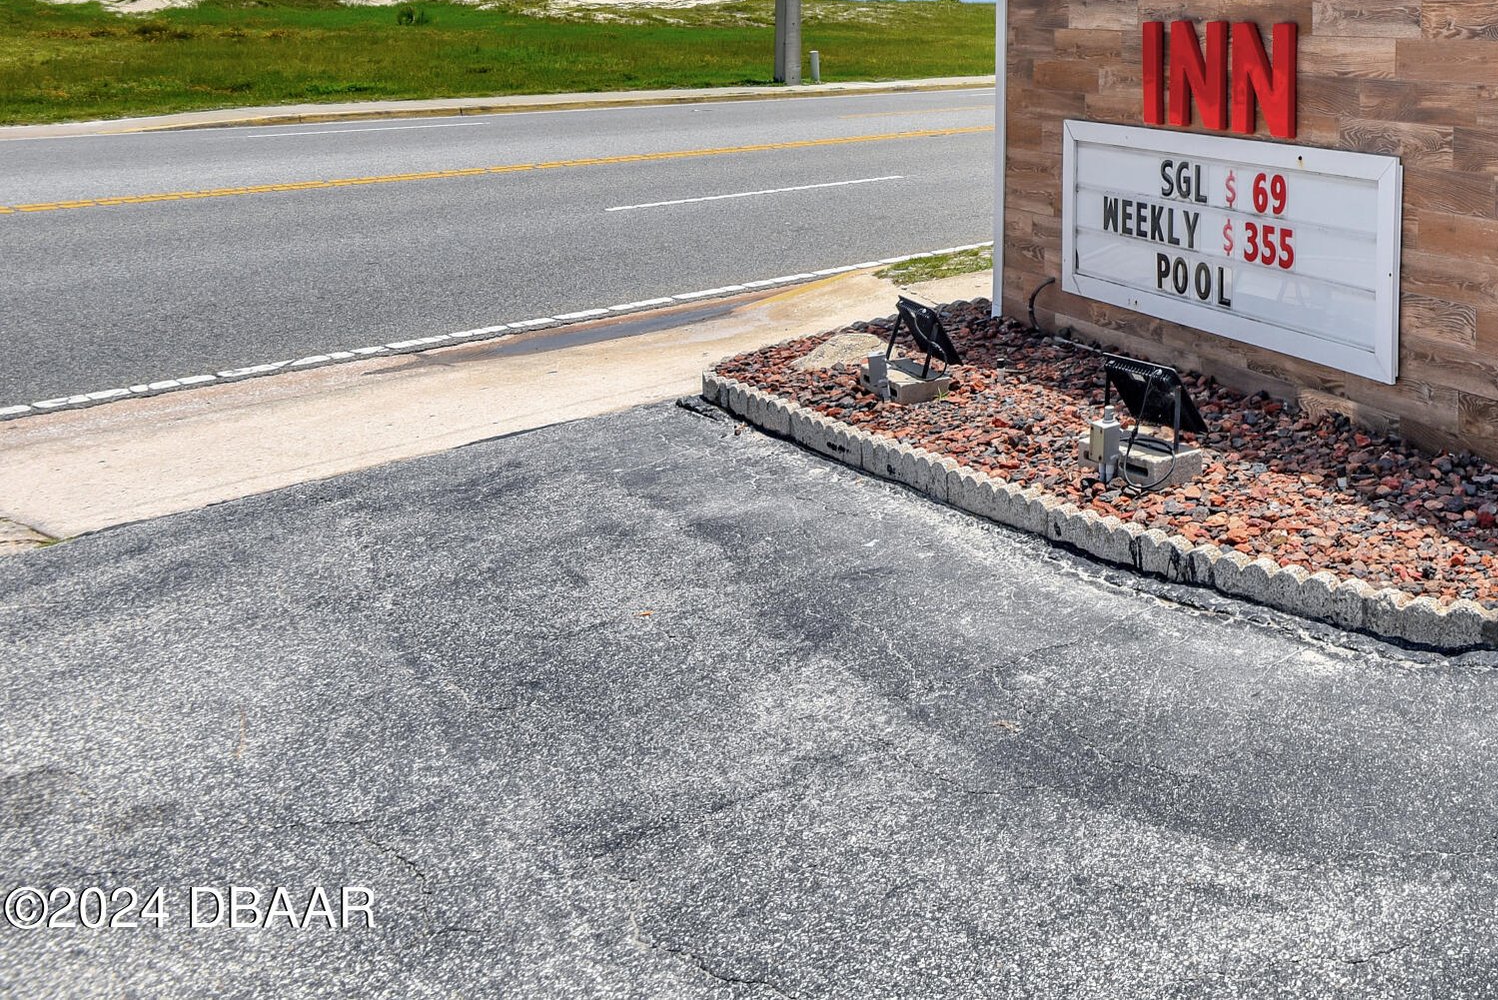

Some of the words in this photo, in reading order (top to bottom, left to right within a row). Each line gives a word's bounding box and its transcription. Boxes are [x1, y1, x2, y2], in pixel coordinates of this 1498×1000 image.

[1142, 20, 1298, 140] INN
[1160, 159, 1208, 203] SGL
[1225, 170, 1237, 209] $
[1252, 172, 1287, 215] 69
[1103, 196, 1200, 249] WEEKLY
[1223, 218, 1234, 256] $
[1243, 222, 1295, 269] 355
[1156, 252, 1232, 307] POOL
